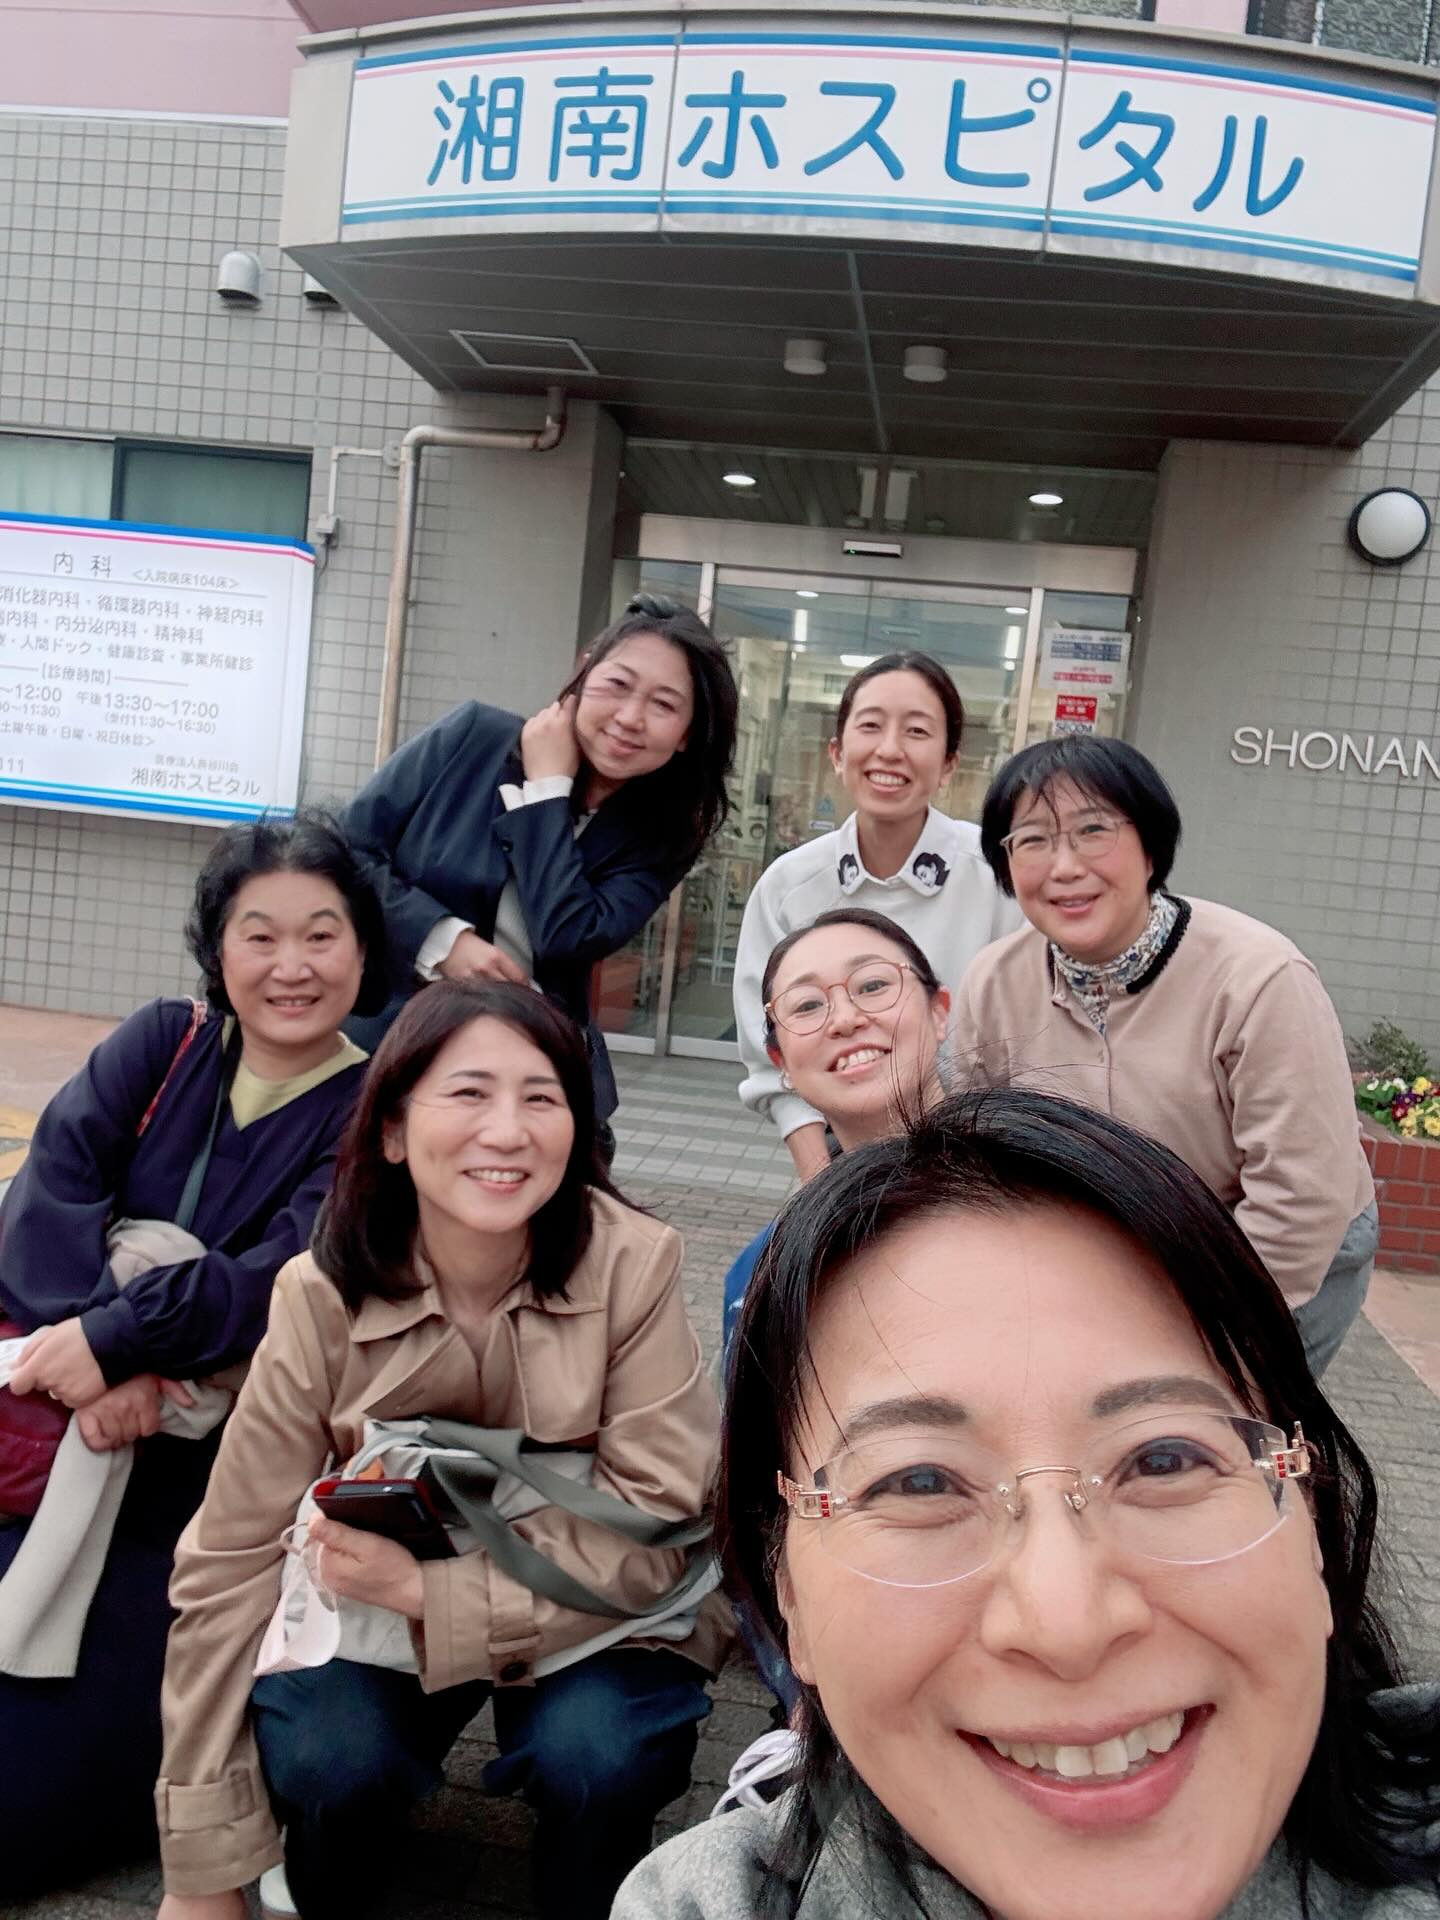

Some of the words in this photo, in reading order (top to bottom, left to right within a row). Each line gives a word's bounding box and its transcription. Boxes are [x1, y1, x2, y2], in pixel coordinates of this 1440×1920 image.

[426, 66, 1306, 218] 湘南ホスピタル
[1230, 726, 1440, 780] SHONAN
[131, 767, 262, 797] 湘南ホスピタル
